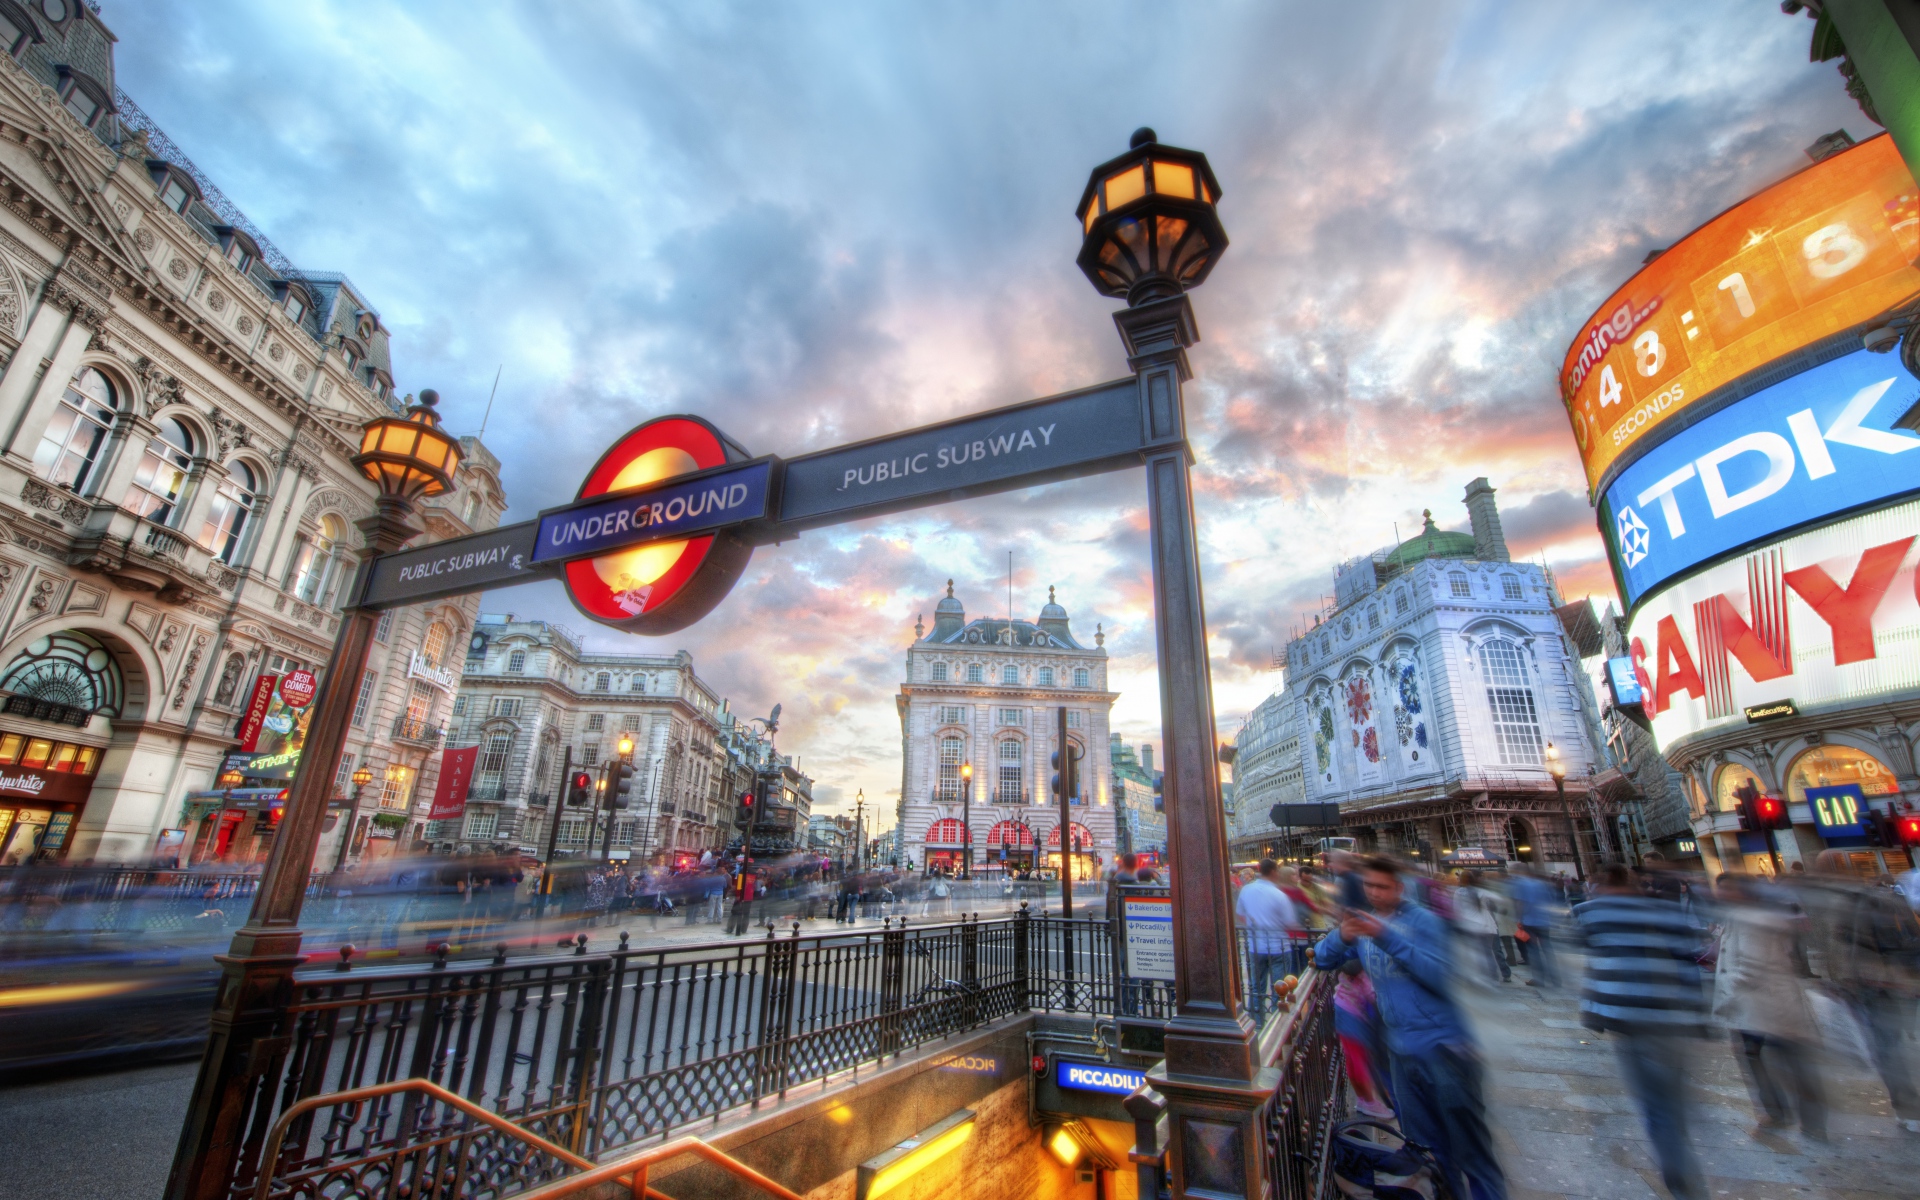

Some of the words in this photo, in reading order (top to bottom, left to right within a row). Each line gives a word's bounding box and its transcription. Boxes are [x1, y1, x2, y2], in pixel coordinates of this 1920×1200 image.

[1612, 383, 1685, 446] SECONDS
[843, 453, 928, 489] PUBLIC
[936, 423, 1057, 468] SUBWAY
[1637, 376, 1920, 540] TDK
[551, 483, 748, 546] UNDERGROUND
[399, 559, 446, 582] PUBLIC
[447, 545, 511, 572] SUBWAY
[1630, 534, 1920, 720] SANY
[293, 672, 312, 683] BEST
[407, 649, 455, 693] Lillywhites
[284, 679, 314, 694] COMEDY
[250, 709, 262, 726] 39
[1816, 796, 1858, 826] GAP
[44, 835, 65, 845] ONL
[1679, 841, 1695, 852] GAP
[1134, 904, 1163, 912] Bakerloo
[1135, 923, 1166, 932] Piccadilly
[1135, 936, 1156, 944] Travel
